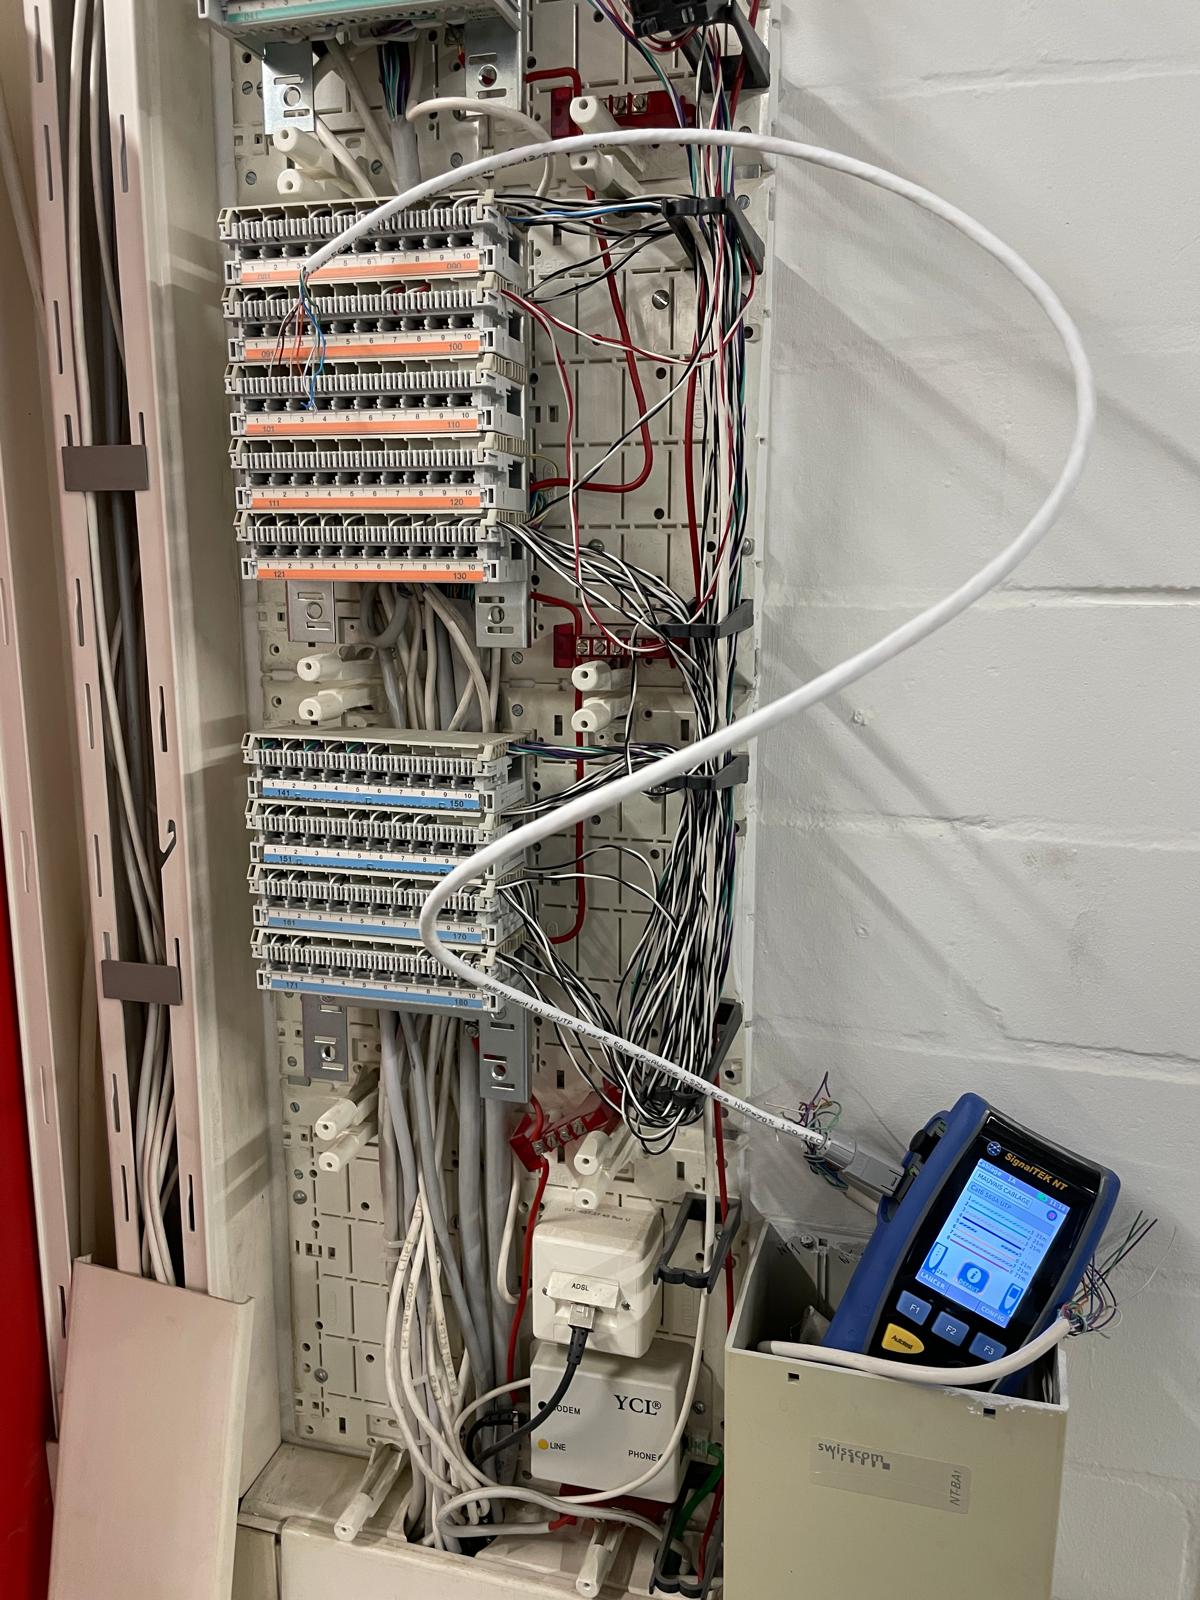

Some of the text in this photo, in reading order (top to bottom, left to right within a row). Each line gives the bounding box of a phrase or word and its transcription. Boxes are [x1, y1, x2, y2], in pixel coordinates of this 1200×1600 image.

[1004, 1152, 1068, 1192] SignalTEK NT
[977, 1173, 1003, 1190] MAUVAIS
[920, 1272, 945, 1289] LANCER
[571, 1282, 589, 1292] ADSL
[910, 1304, 920, 1314] F1
[981, 1306, 1005, 1322] CONFIG
[946, 1325, 957, 1335] F2
[984, 1345, 994, 1355] F3
[553, 1404, 580, 1415] ODEM
[550, 1442, 566, 1451] LINE
[628, 1450, 656, 1461] PHONE
[818, 1442, 884, 1465] swisscom
